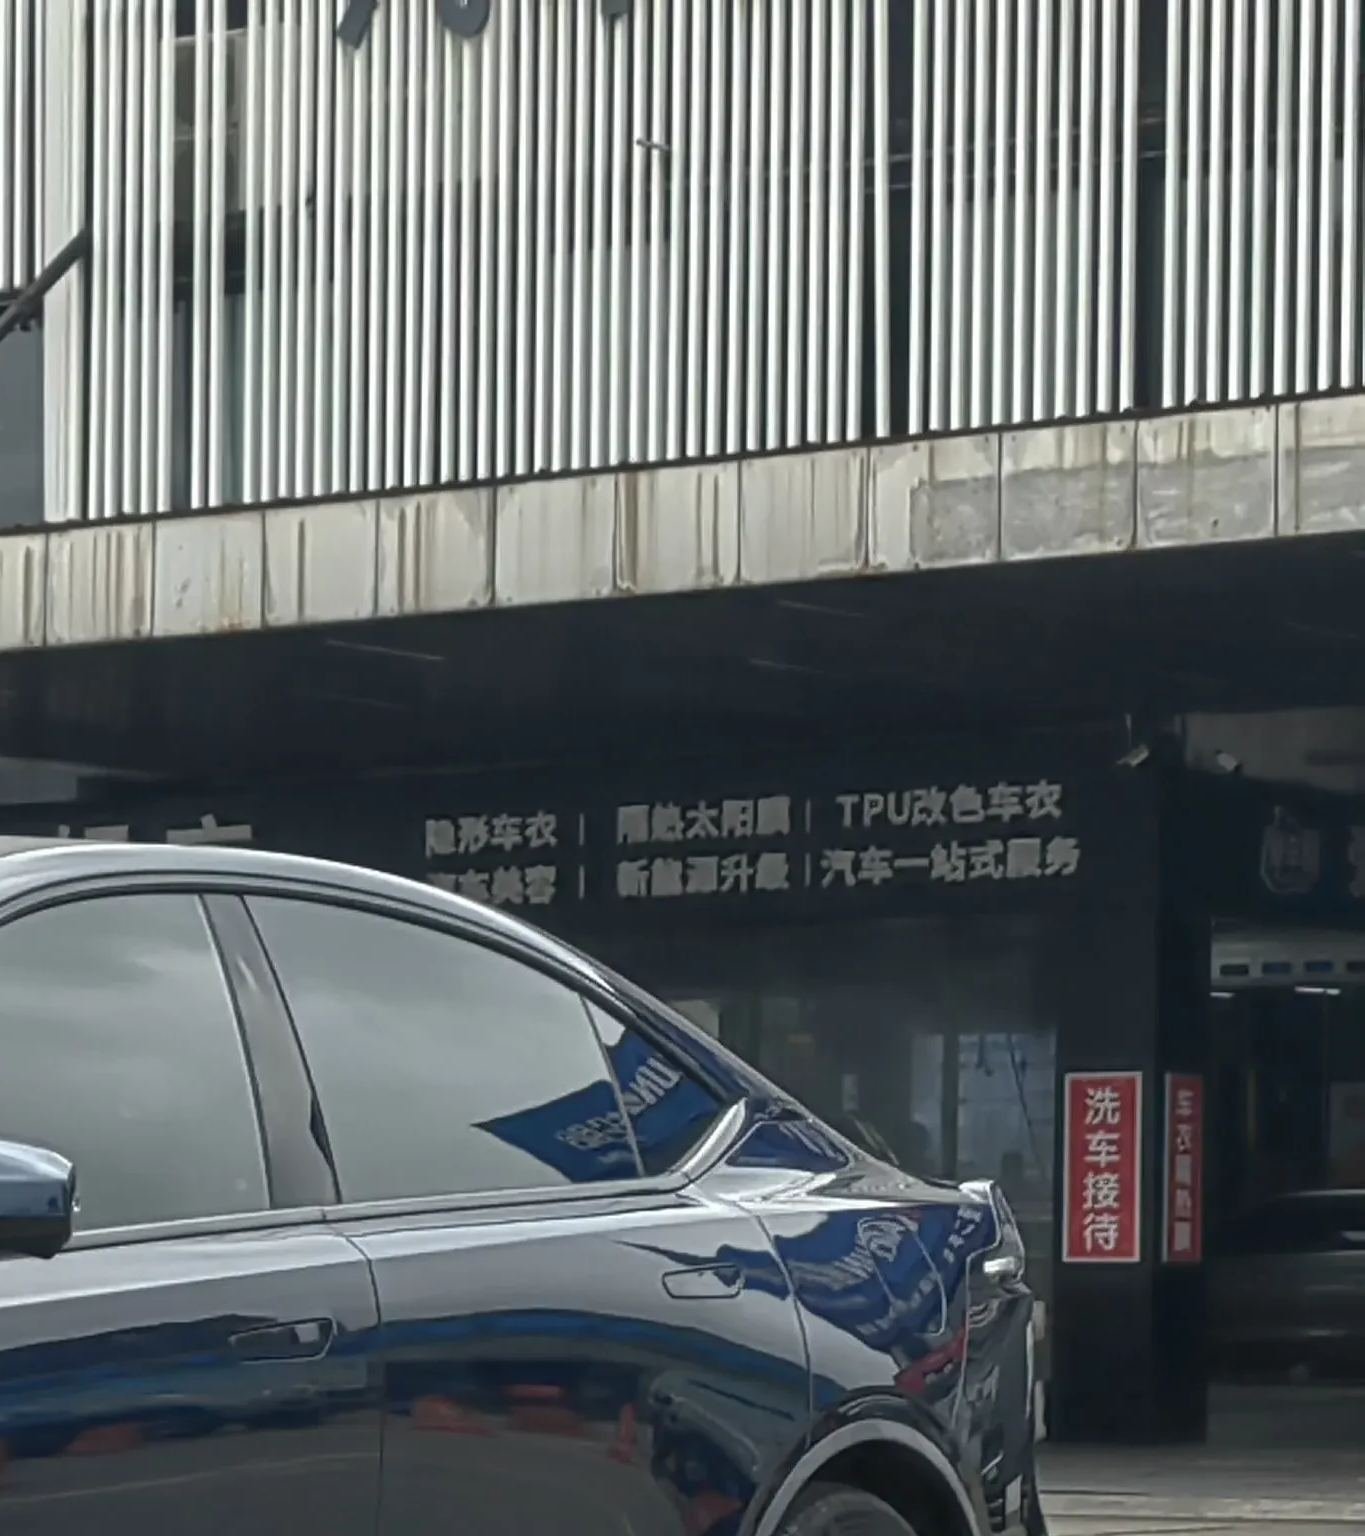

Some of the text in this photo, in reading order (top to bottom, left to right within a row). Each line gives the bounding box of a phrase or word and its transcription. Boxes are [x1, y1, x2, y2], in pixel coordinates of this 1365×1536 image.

[819, 835, 1082, 889] 汽车一站式服务
[1082, 1087, 1121, 1253] 洗车接待
